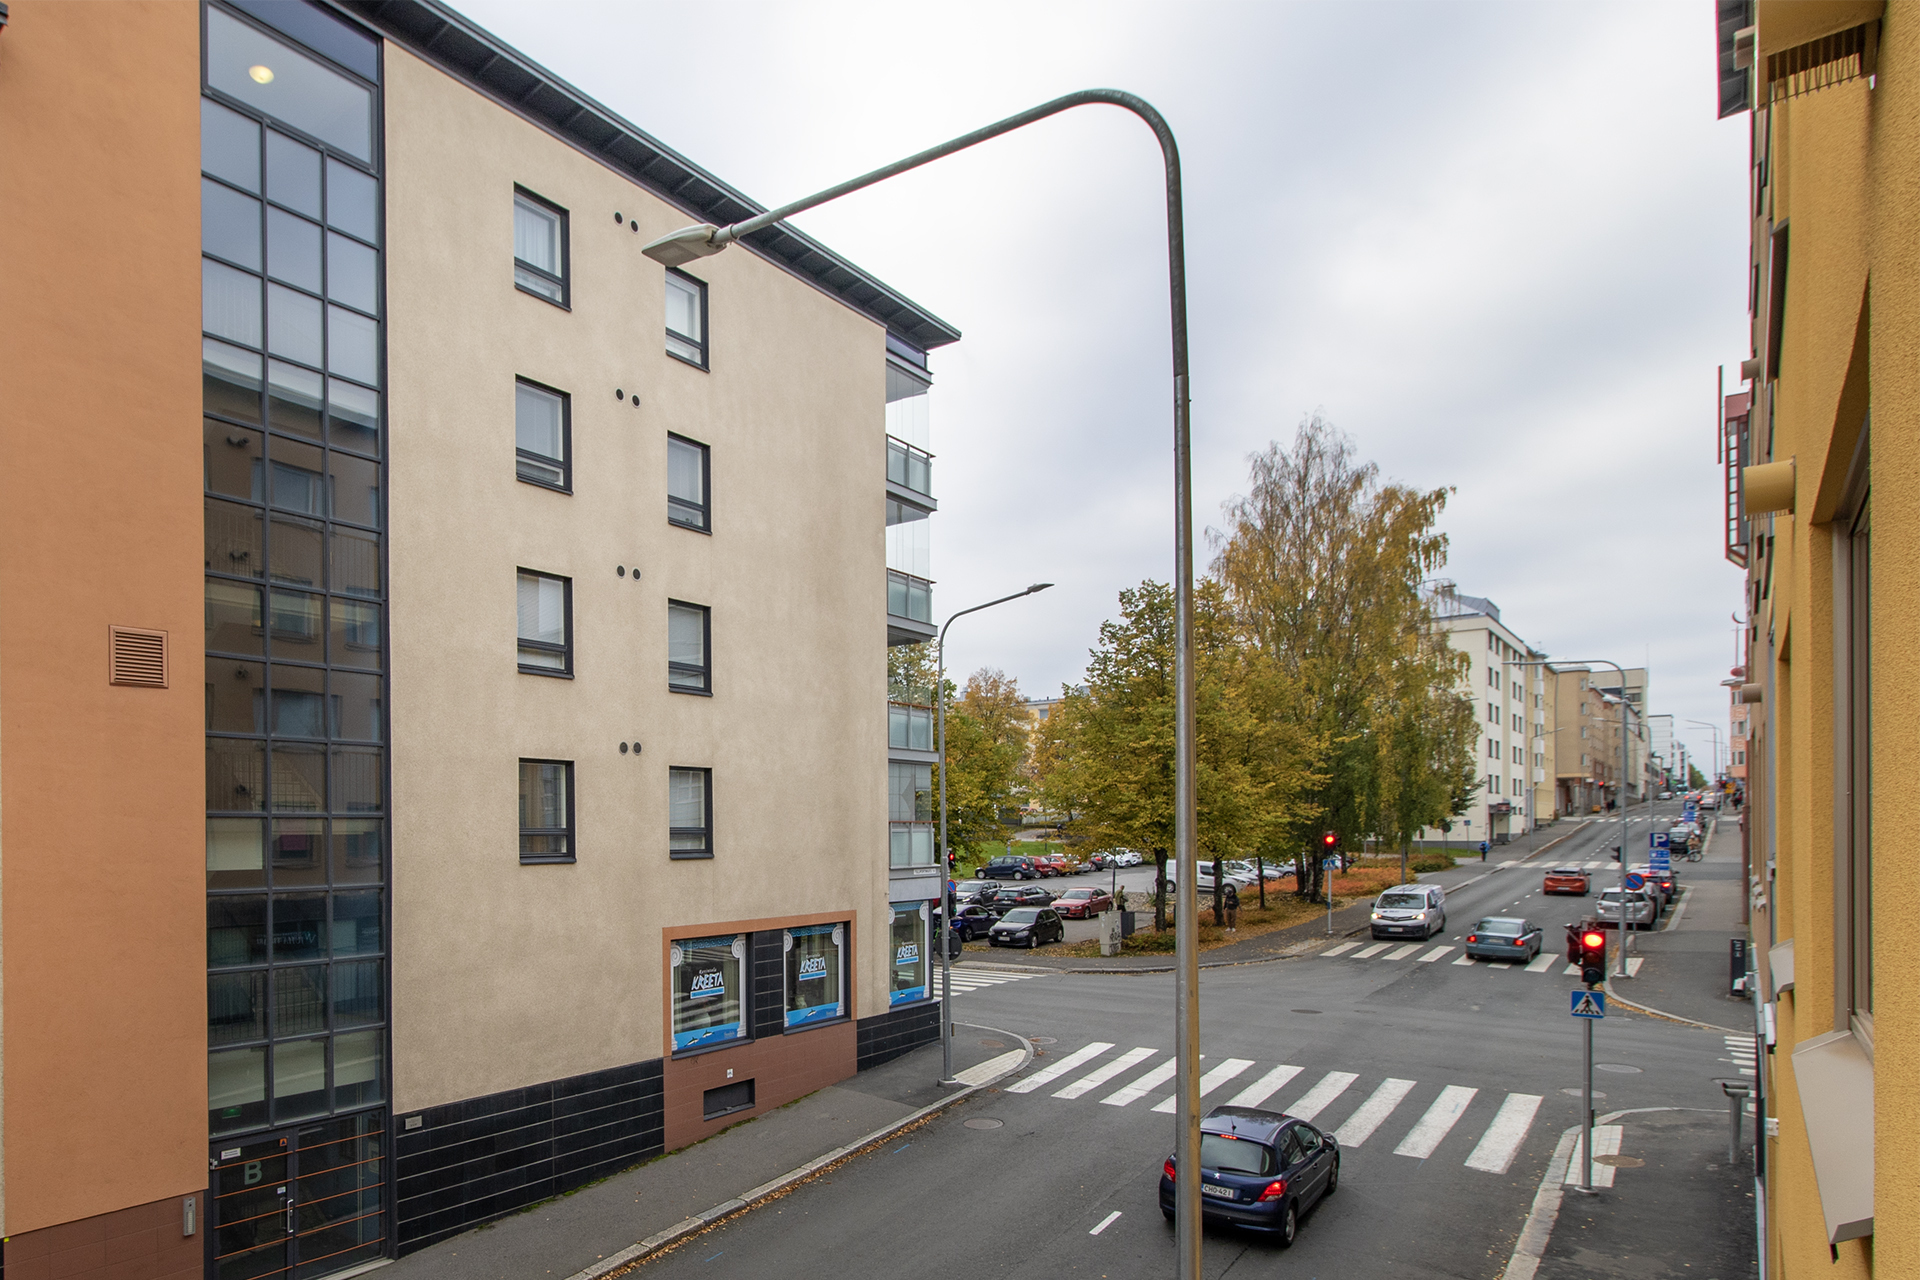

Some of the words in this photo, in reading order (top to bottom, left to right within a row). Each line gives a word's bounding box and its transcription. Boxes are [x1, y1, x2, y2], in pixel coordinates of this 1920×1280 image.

[1653, 834, 1668, 847] P
[897, 944, 919, 958] KREETA
[799, 956, 826, 973] KREETA
[691, 971, 724, 990] KREETA
[244, 1161, 262, 1185] B
